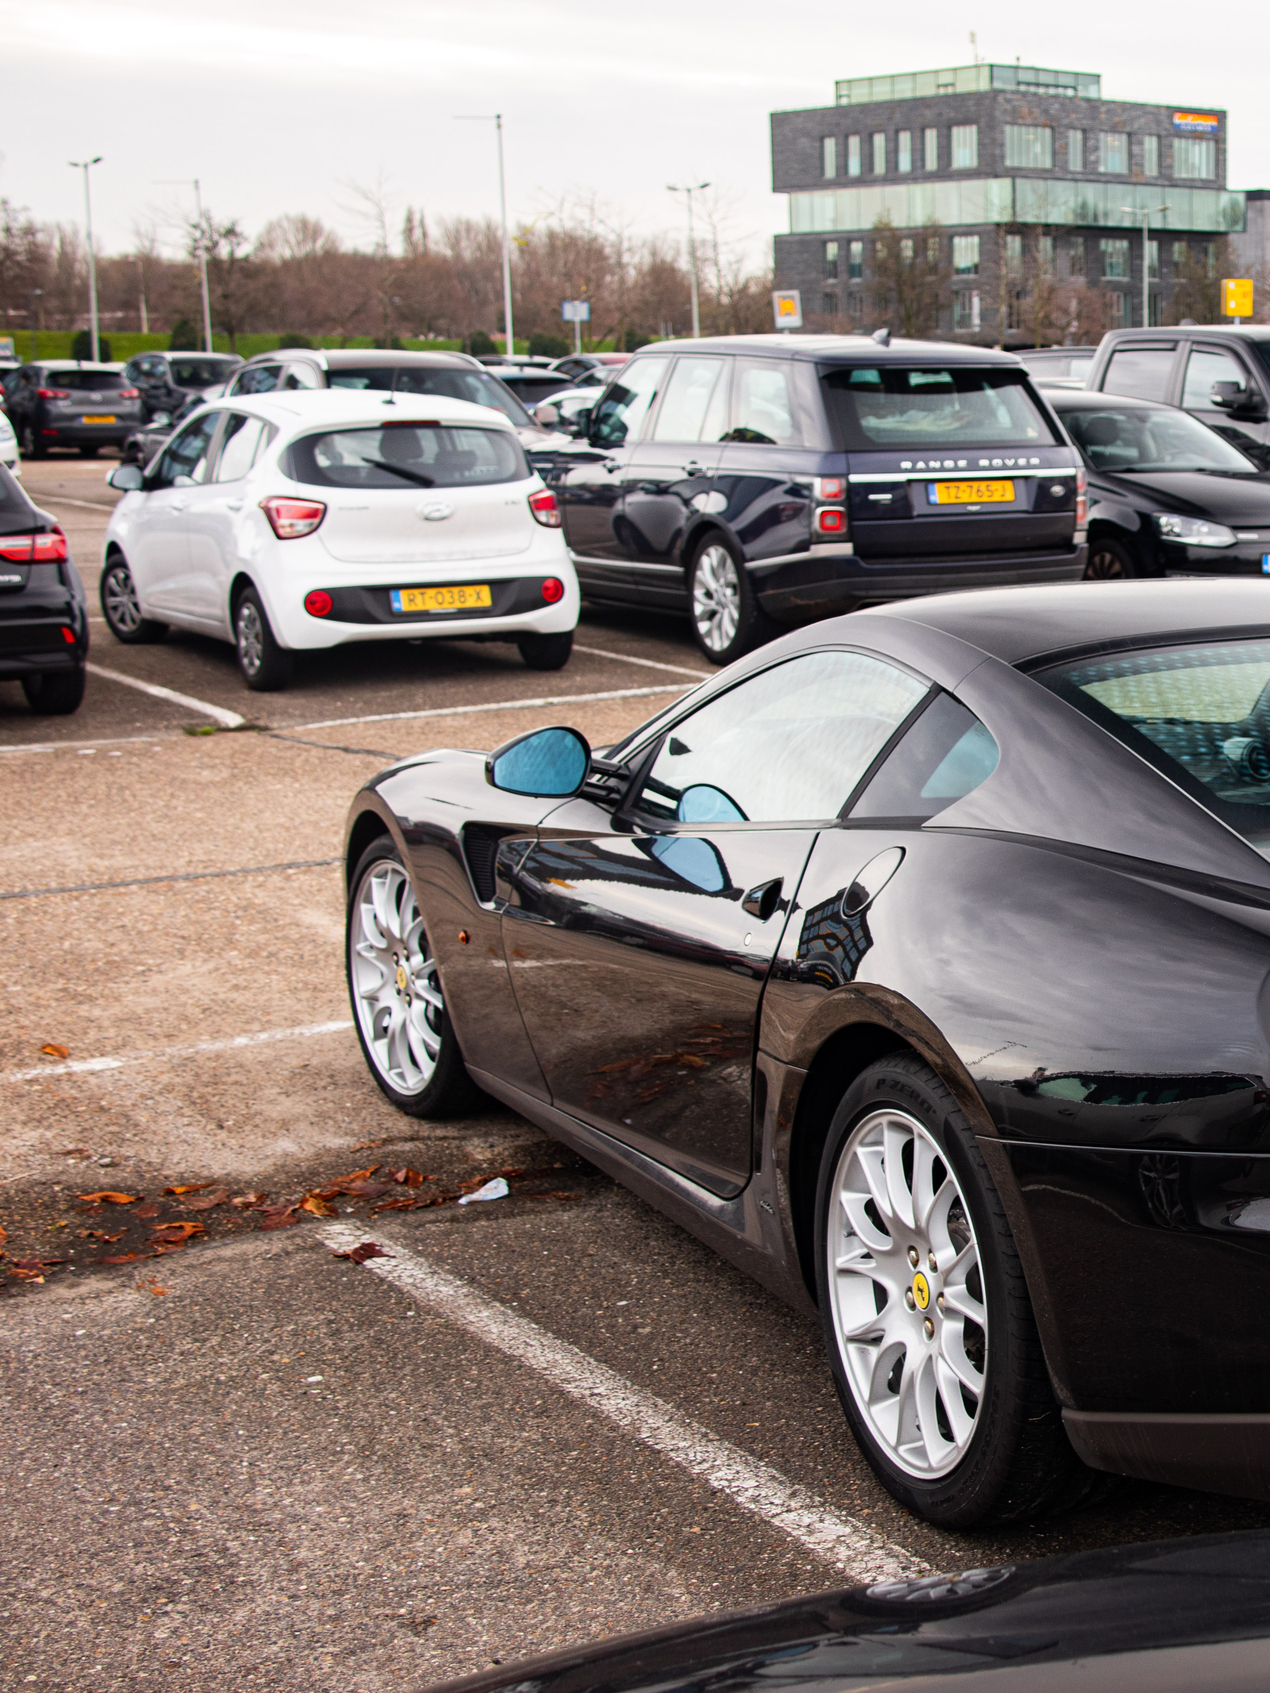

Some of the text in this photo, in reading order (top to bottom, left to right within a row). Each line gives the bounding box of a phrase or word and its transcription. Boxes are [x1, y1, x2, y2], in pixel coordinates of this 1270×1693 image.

[900, 457, 1041, 470] RANGE ROVER
[944, 483, 1007, 500] TZ-765-J
[406, 588, 483, 606] RT-038-X
[889, 1079, 933, 1114] ZERO
